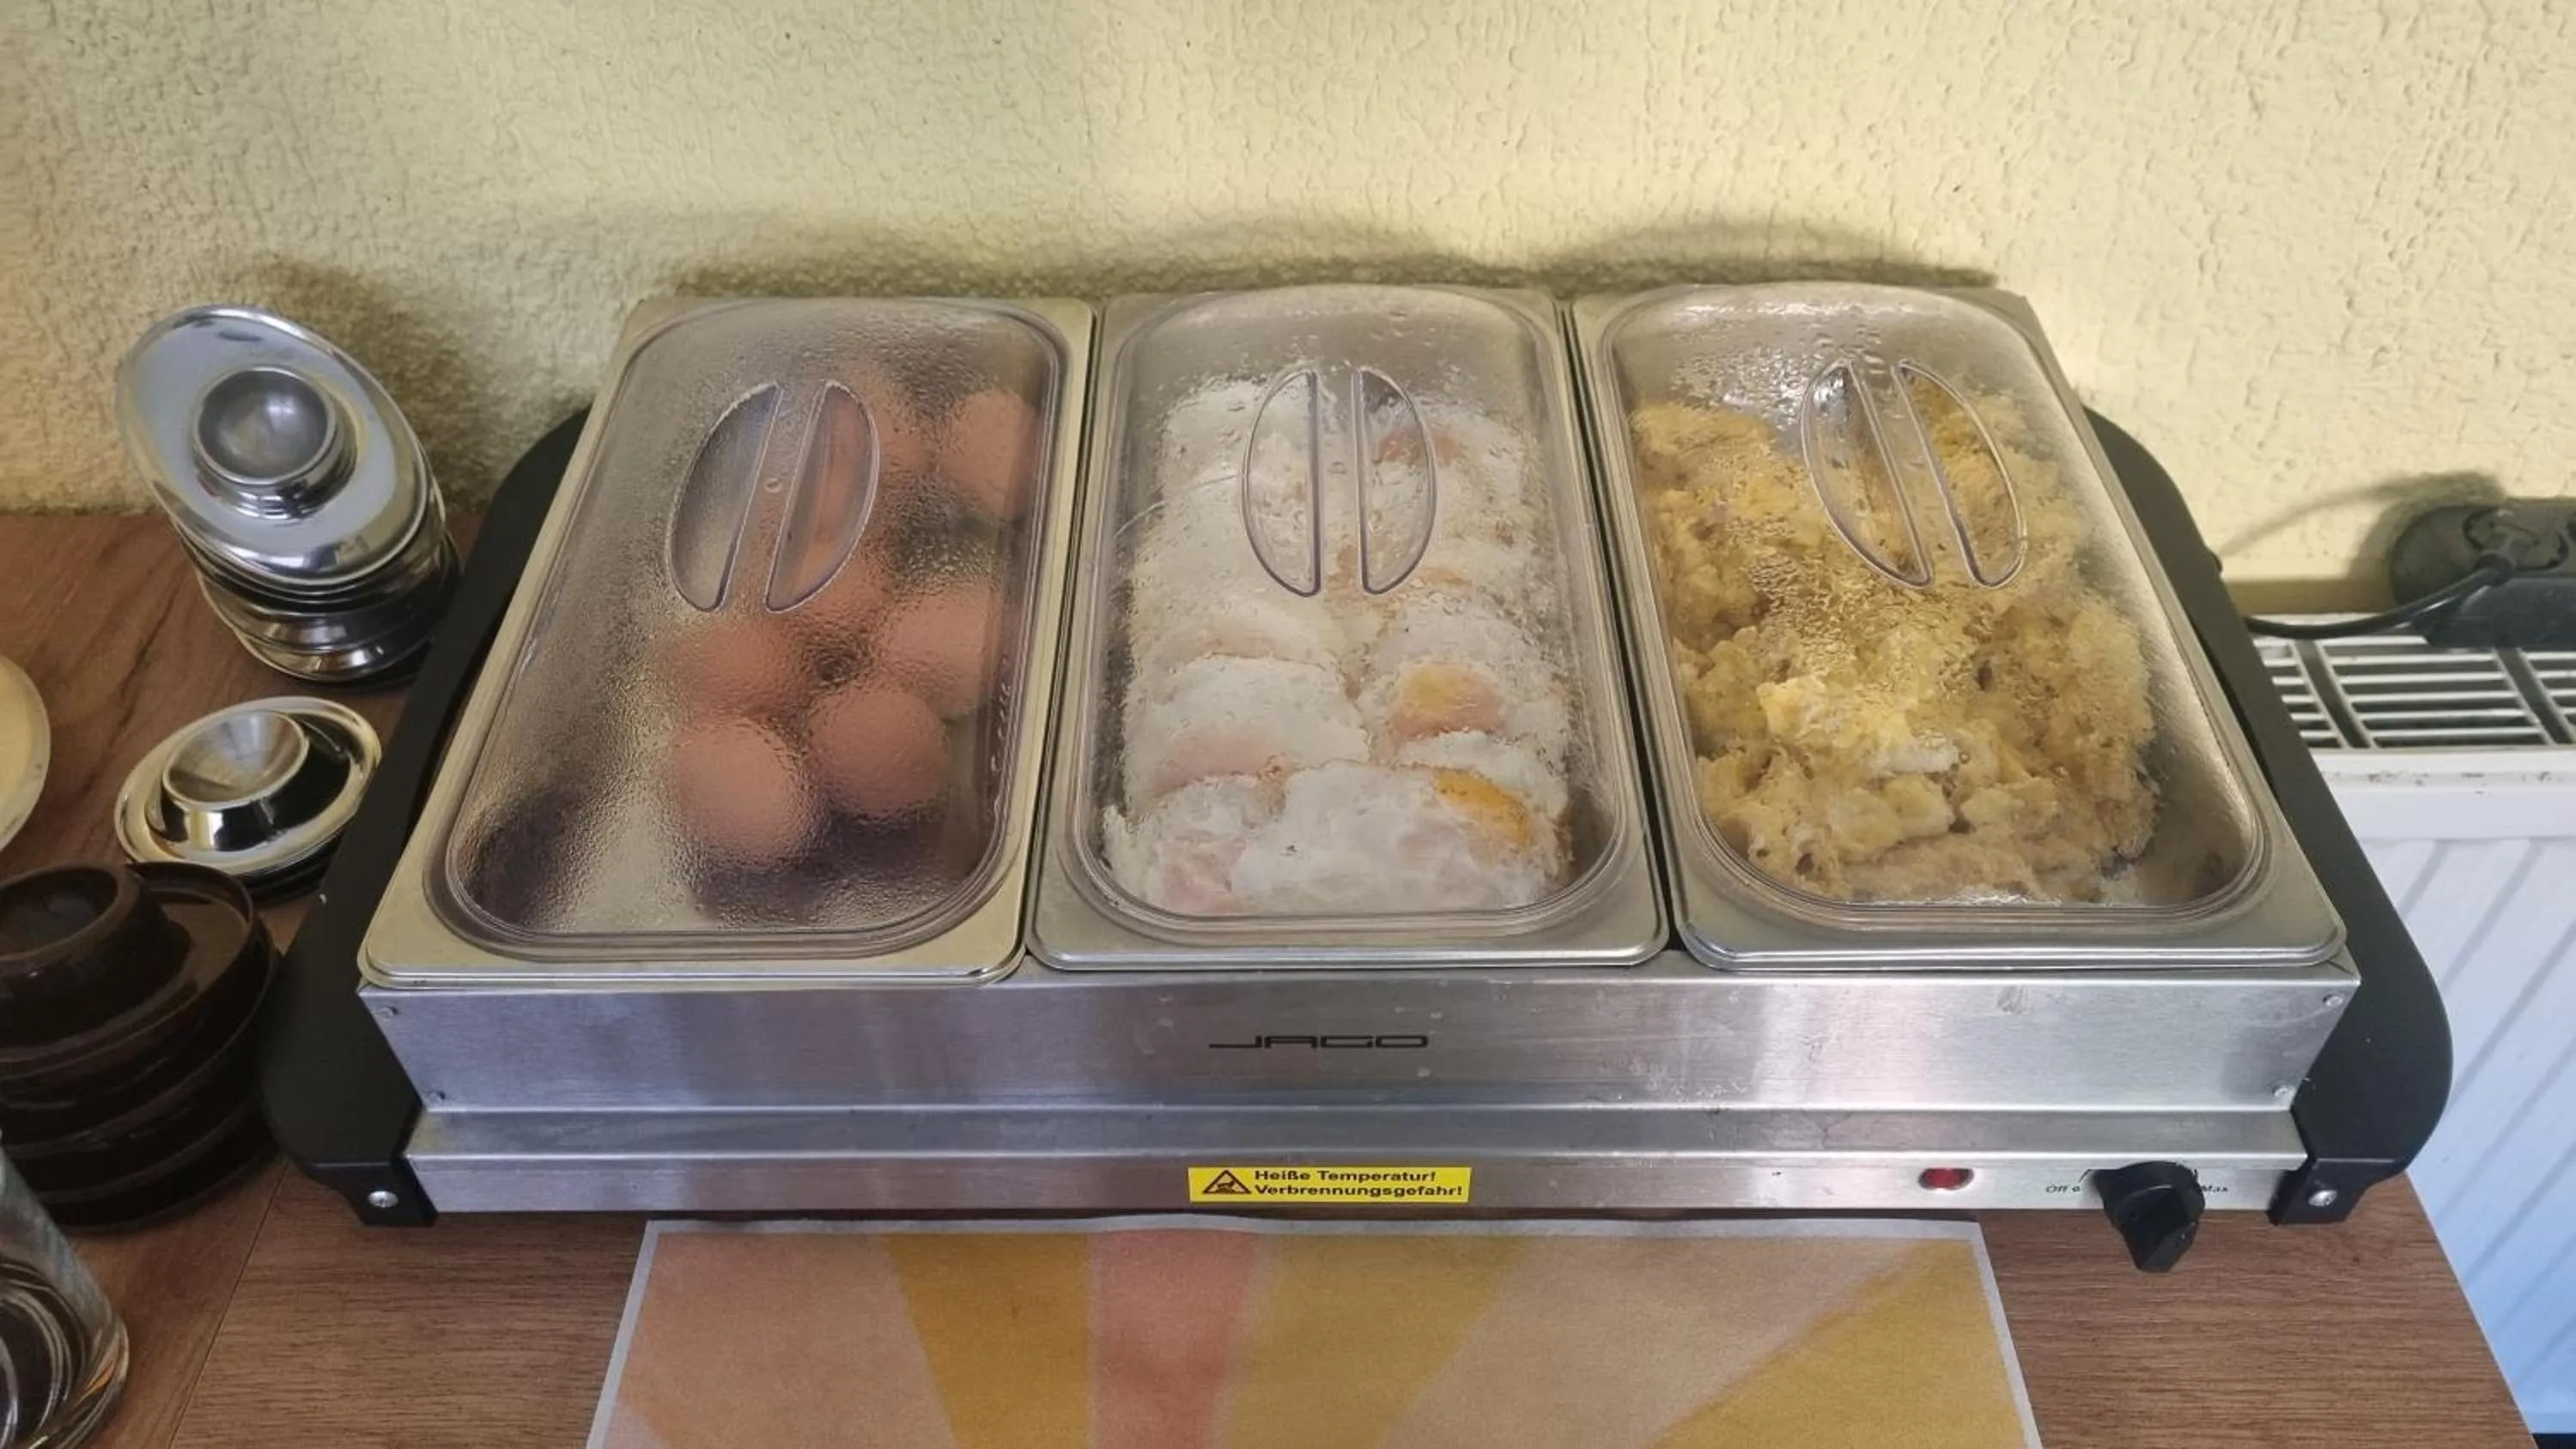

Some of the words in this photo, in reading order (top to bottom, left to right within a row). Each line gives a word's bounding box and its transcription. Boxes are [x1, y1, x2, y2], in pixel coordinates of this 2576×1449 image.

[1209, 1035, 1429, 1049] JAGO
[1255, 1170, 1311, 1181] Heiße
[1317, 1170, 1437, 1183] Temperatur!
[1255, 1185, 1463, 1197] Verbrennungsgefahr!
